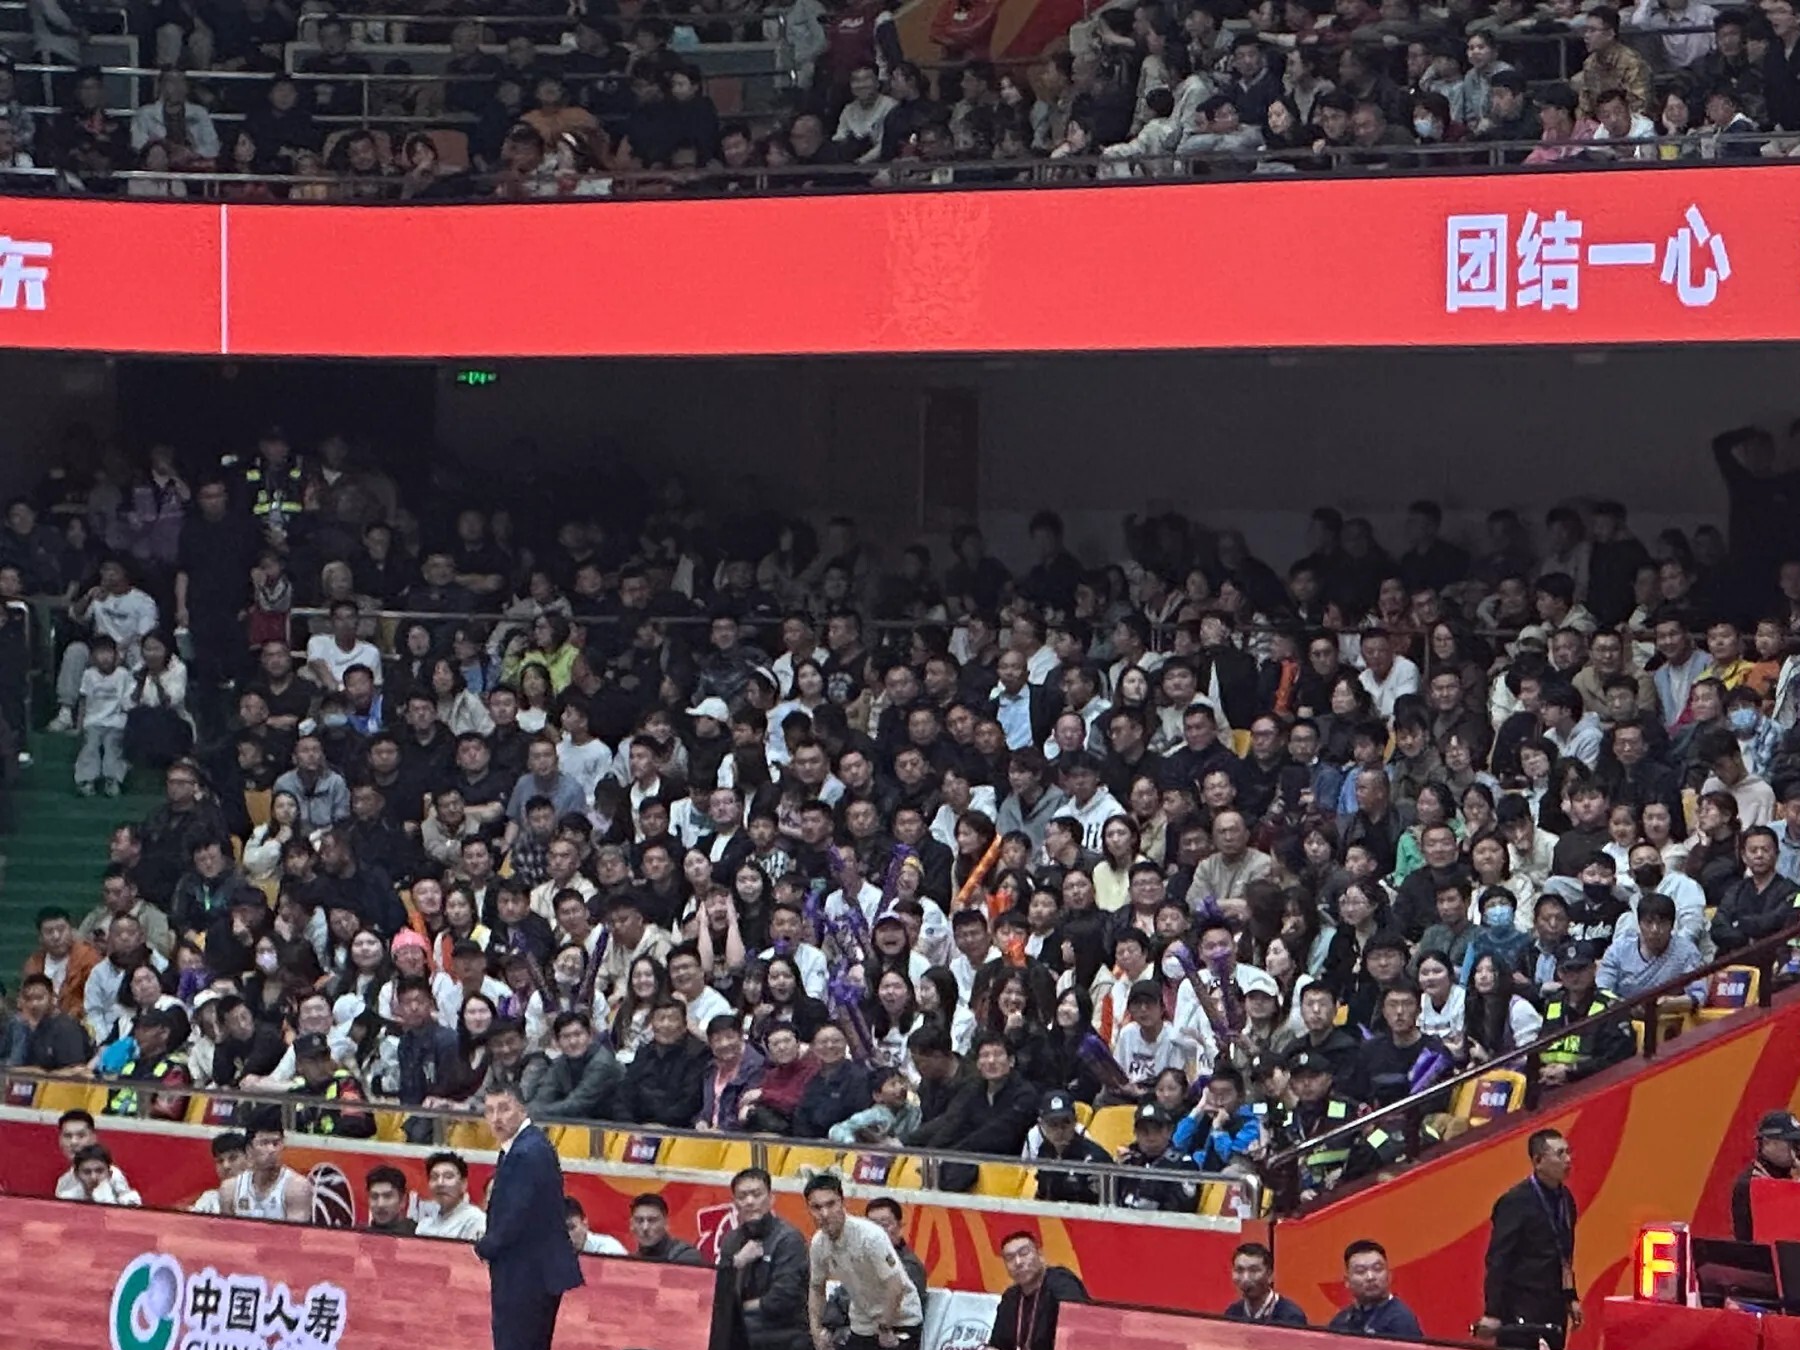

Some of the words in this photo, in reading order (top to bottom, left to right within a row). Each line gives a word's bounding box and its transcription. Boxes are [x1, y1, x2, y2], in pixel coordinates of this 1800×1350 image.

[1446, 204, 1732, 313] 团结一心
[1639, 1229, 1678, 1299] F
[189, 1277, 341, 1342] 中国人寿
